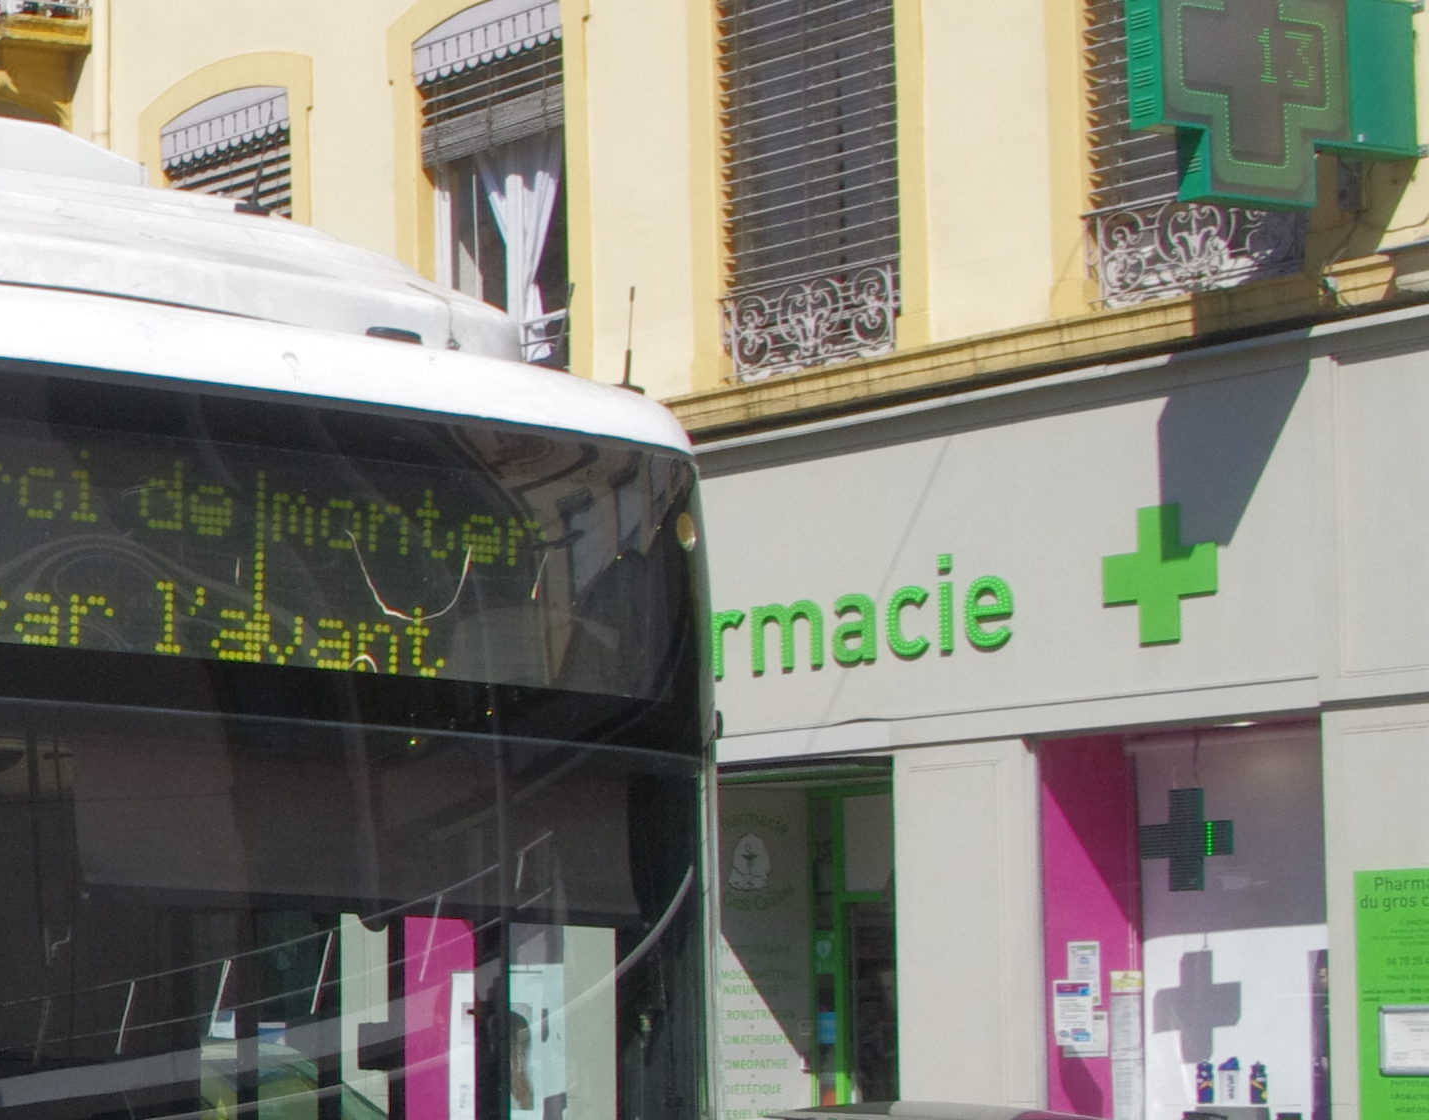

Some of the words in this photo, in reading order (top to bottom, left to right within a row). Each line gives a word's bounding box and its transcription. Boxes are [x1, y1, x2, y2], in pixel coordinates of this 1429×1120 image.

[1257, 27, 1316, 88] 13
[140, 460, 234, 536] de
[272, 489, 547, 567] monter
[1360, 895, 1378, 909] du
[1382, 896, 1417, 912] gros
